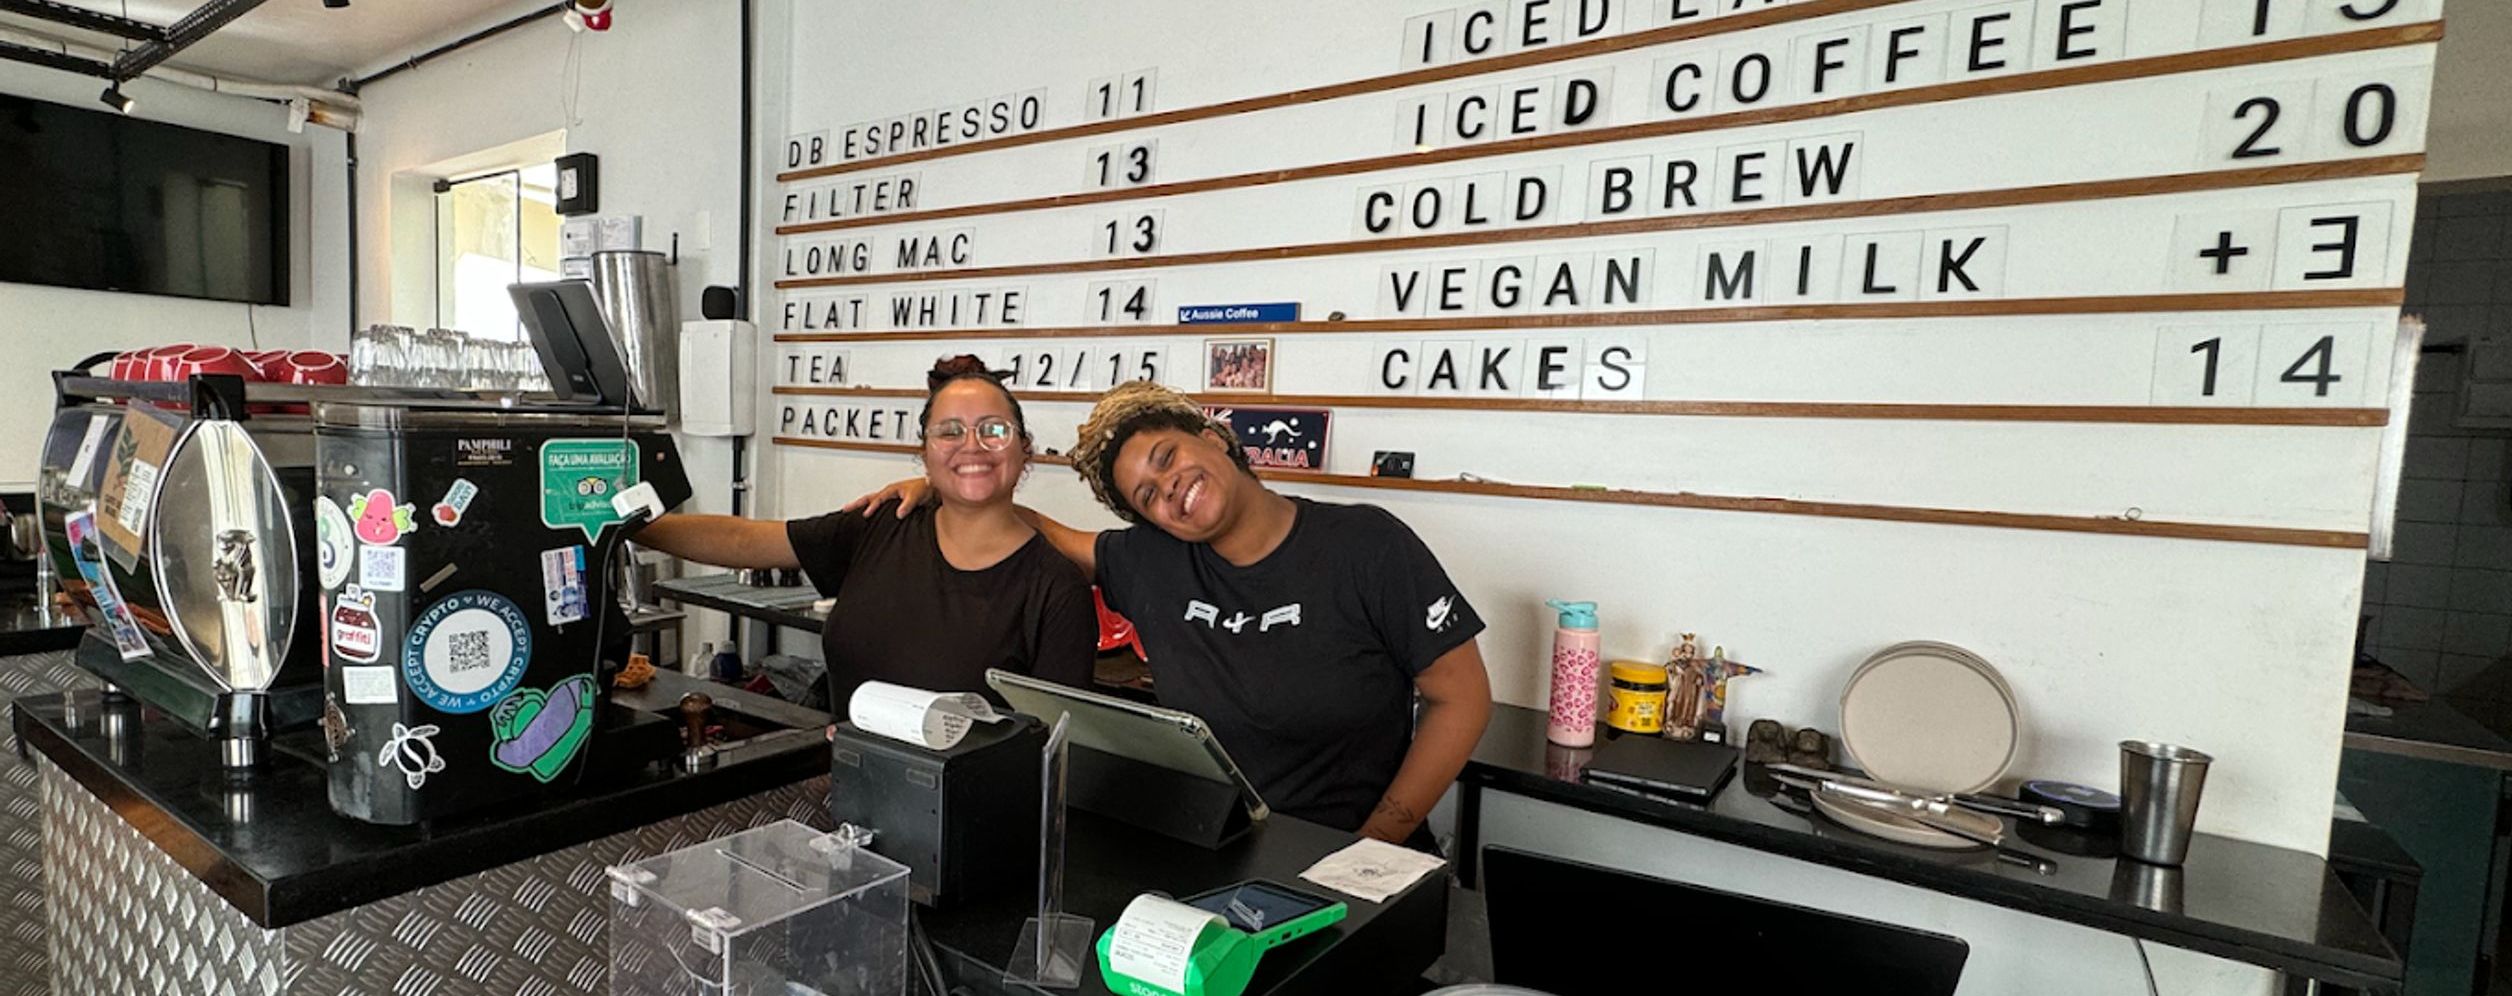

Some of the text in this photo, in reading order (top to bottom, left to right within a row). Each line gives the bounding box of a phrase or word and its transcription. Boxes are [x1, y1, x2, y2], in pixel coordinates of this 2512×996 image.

[1423, 0, 1609, 62] ICED
[1415, 79, 1597, 146] ICED
[1665, 0, 2101, 112] COFFEE
[789, 77, 1145, 168] DB ESPRESSO 11
[784, 146, 1148, 221] FILTER 13
[1365, 83, 2395, 233] COLD BREW 20
[787, 215, 1154, 276] LONG MAC 13
[1391, 258, 1639, 311] VEGAN
[1706, 237, 1985, 300] MILK
[784, 286, 1145, 330] FLAT WHITE 14
[1191, 307, 1259, 320] Aussie Coffee
[789, 355, 842, 384] TEA
[1383, 335, 2341, 396] CAKES 14
[1243, 446, 1310, 468] RALIA
[408, 598, 461, 708] WE ACCEPT CRYPTO
[476, 595, 527, 703] WE ACCEPT CRYPTO
